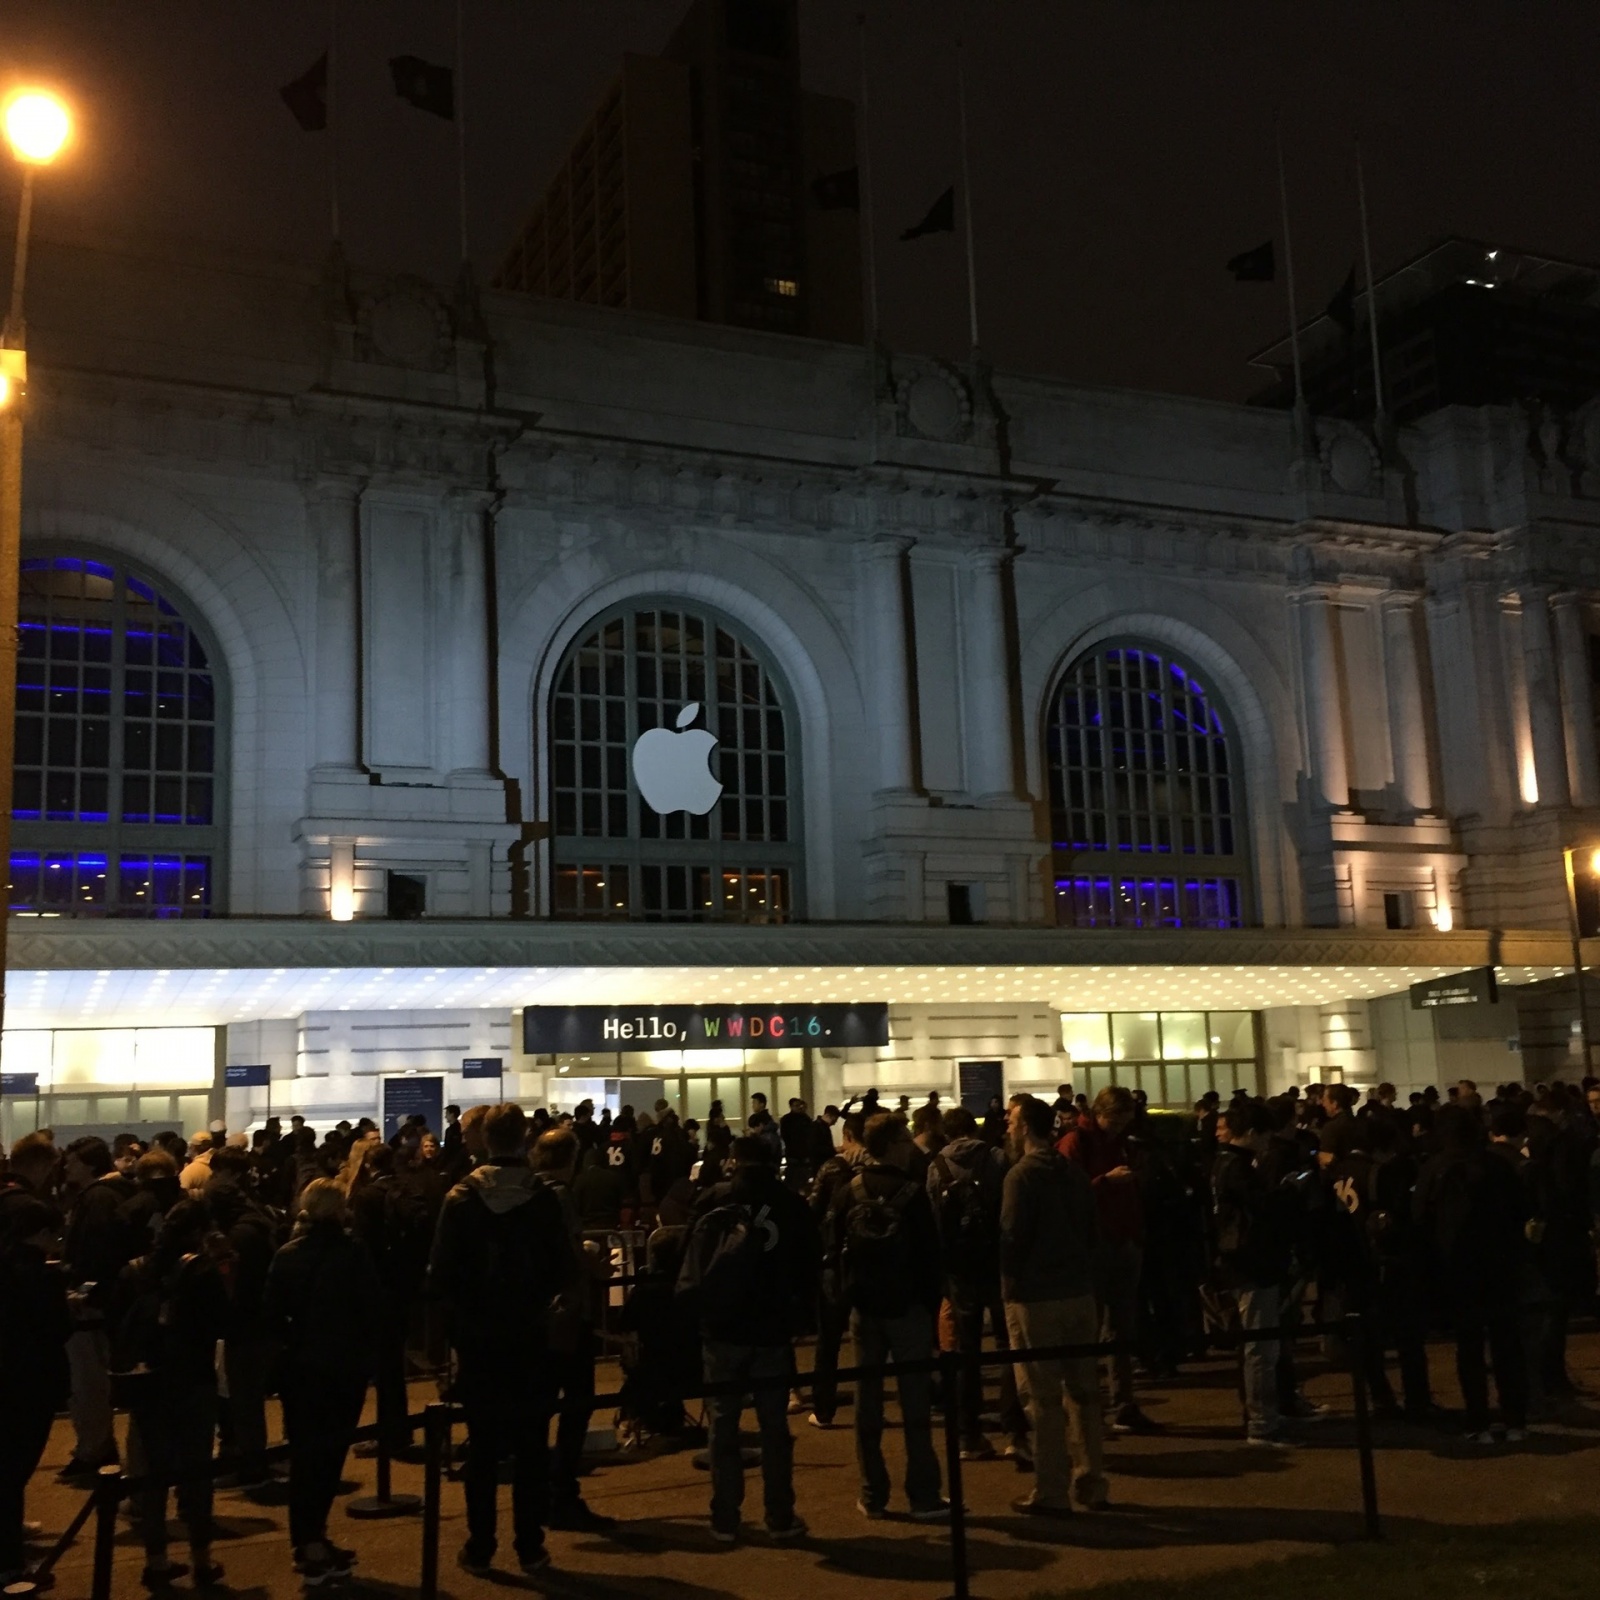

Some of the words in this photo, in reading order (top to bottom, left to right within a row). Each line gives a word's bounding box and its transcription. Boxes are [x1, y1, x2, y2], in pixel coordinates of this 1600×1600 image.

[603, 1016, 687, 1042] Hello,
[606, 1146, 626, 1166] 16
[1333, 1176, 1360, 1214] 16
